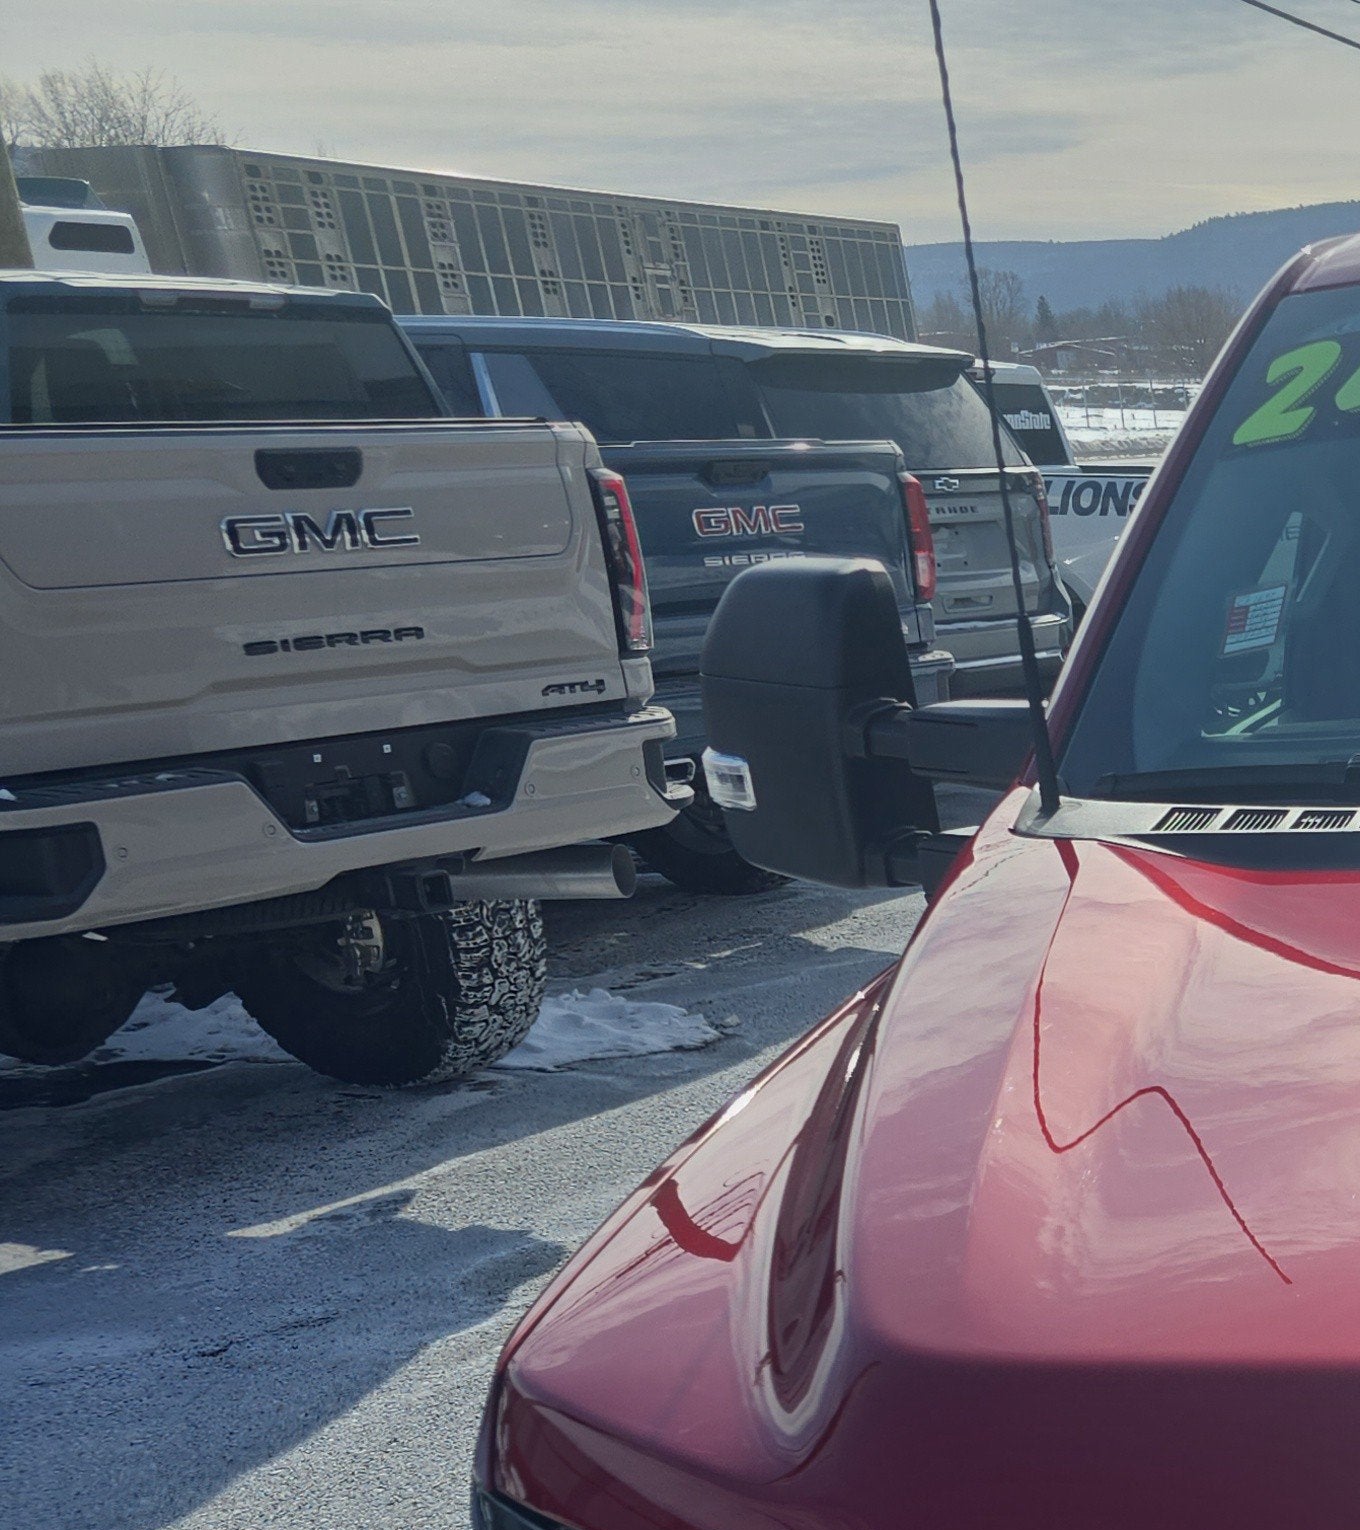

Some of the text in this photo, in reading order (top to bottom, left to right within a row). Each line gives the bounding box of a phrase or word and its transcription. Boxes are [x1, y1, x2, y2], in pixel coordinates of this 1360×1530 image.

[221, 507, 420, 557] GMC
[692, 504, 804, 537] GMC
[243, 626, 424, 656] SIERRA
[541, 678, 606, 697] AT4
